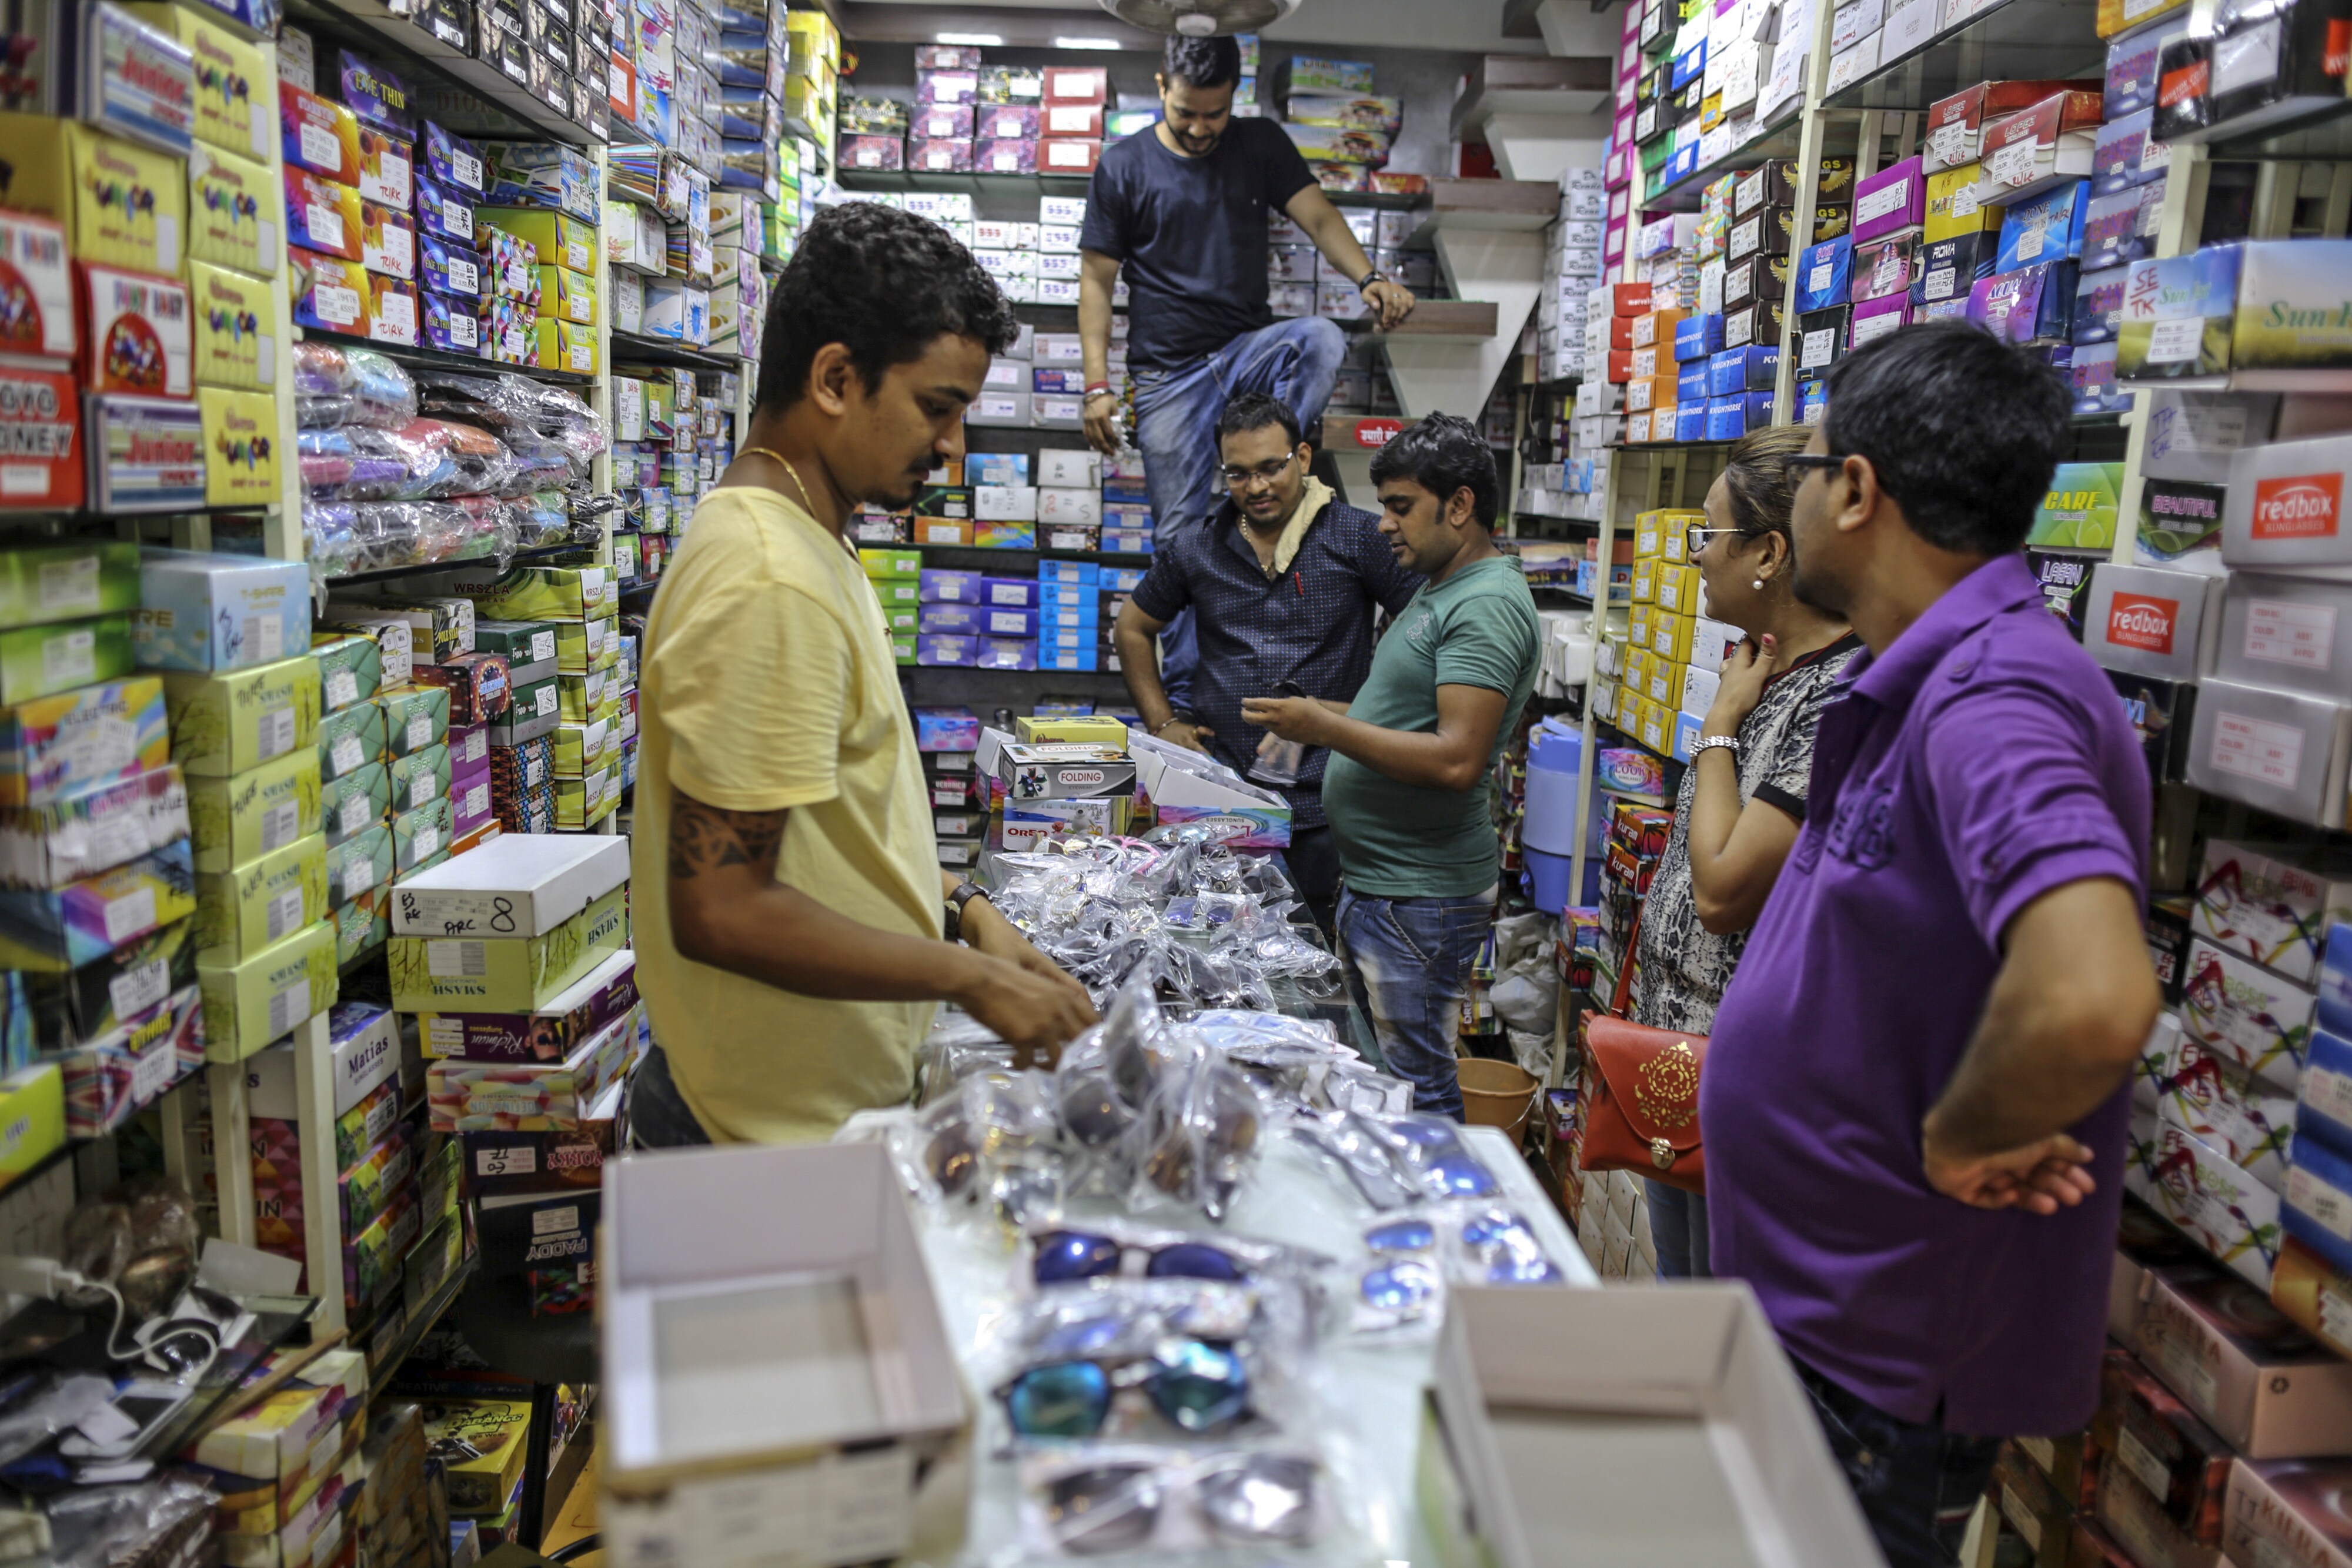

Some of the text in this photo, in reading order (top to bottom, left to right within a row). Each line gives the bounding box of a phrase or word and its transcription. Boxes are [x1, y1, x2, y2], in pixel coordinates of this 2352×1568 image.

[2109, 47, 2159, 88] CANDY
[355, 71, 405, 109] EYE THIN
[1943, 101, 1966, 118] LOPEZ
[2004, 115, 2036, 138] LOPEZ
[2096, 130, 2147, 170] CANDY
[1995, 162, 2007, 171] COLOR:
[2088, 207, 2139, 242] CANDY
[1932, 243, 1955, 259] ROMA
[1986, 278, 2019, 300] AQUA
[2090, 281, 2126, 314] CAN
[2159, 285, 2189, 305] Sun
[1928, 304, 1957, 316] ARISTO
[1988, 300, 2011, 310] SUNGLASSES
[2264, 300, 2329, 328] Sun
[1676, 332, 1703, 345] KNIGHTHORSE
[2298, 333, 2352, 345] SUNGLASSE
[1712, 356, 1742, 370] KNIGHTHORSE
[1678, 407, 1703, 416] KNIGHTHORSE
[1709, 403, 1741, 414] KNIGHTHORSE
[0, 424, 72, 457] ONEY
[124, 434, 196, 465] Junior
[2044, 490, 2103, 511] CARE
[2151, 494, 2217, 519] BEAUTIFUL
[2257, 493, 2333, 522] redbox
[2053, 512, 2086, 520] SUNGLASSES
[2266, 520, 2326, 533] SUNGLASSES
[454, 583, 510, 595] WRSZLA
[586, 587, 602, 597] WRSZLA
[2113, 609, 2169, 636] redbox
[438, 630, 449, 644] POLE
[590, 638, 603, 650] WRSZLA
[2115, 631, 2163, 647] SUNGLASSES
[589, 688, 602, 701] WRSZLA
[407, 699, 430, 717] POSH
[586, 740, 603, 753] WRSZLA
[412, 755, 432, 774] POSH
[1615, 764, 1645, 777] LOOK
[1061, 772, 1102, 782] FOLDING
[587, 789, 602, 805] WRSZLA
[414, 809, 435, 829] POSH
[1618, 818, 1638, 841] kuram
[1612, 856, 1634, 880] kuram
[342, 907, 372, 937] POSH
[491, 897, 515, 932] 8
[445, 919, 476, 935] ARC
[588, 913, 620, 946] SMASH
[433, 985, 486, 995] SMASH
[348, 1036, 388, 1078] Matias
[354, 1058, 383, 1086] SUNGLASSES
[470, 1101, 537, 1113] DEFINATION
[547, 1150, 604, 1170] YORKY
[525, 1238, 587, 1262] PADDY
